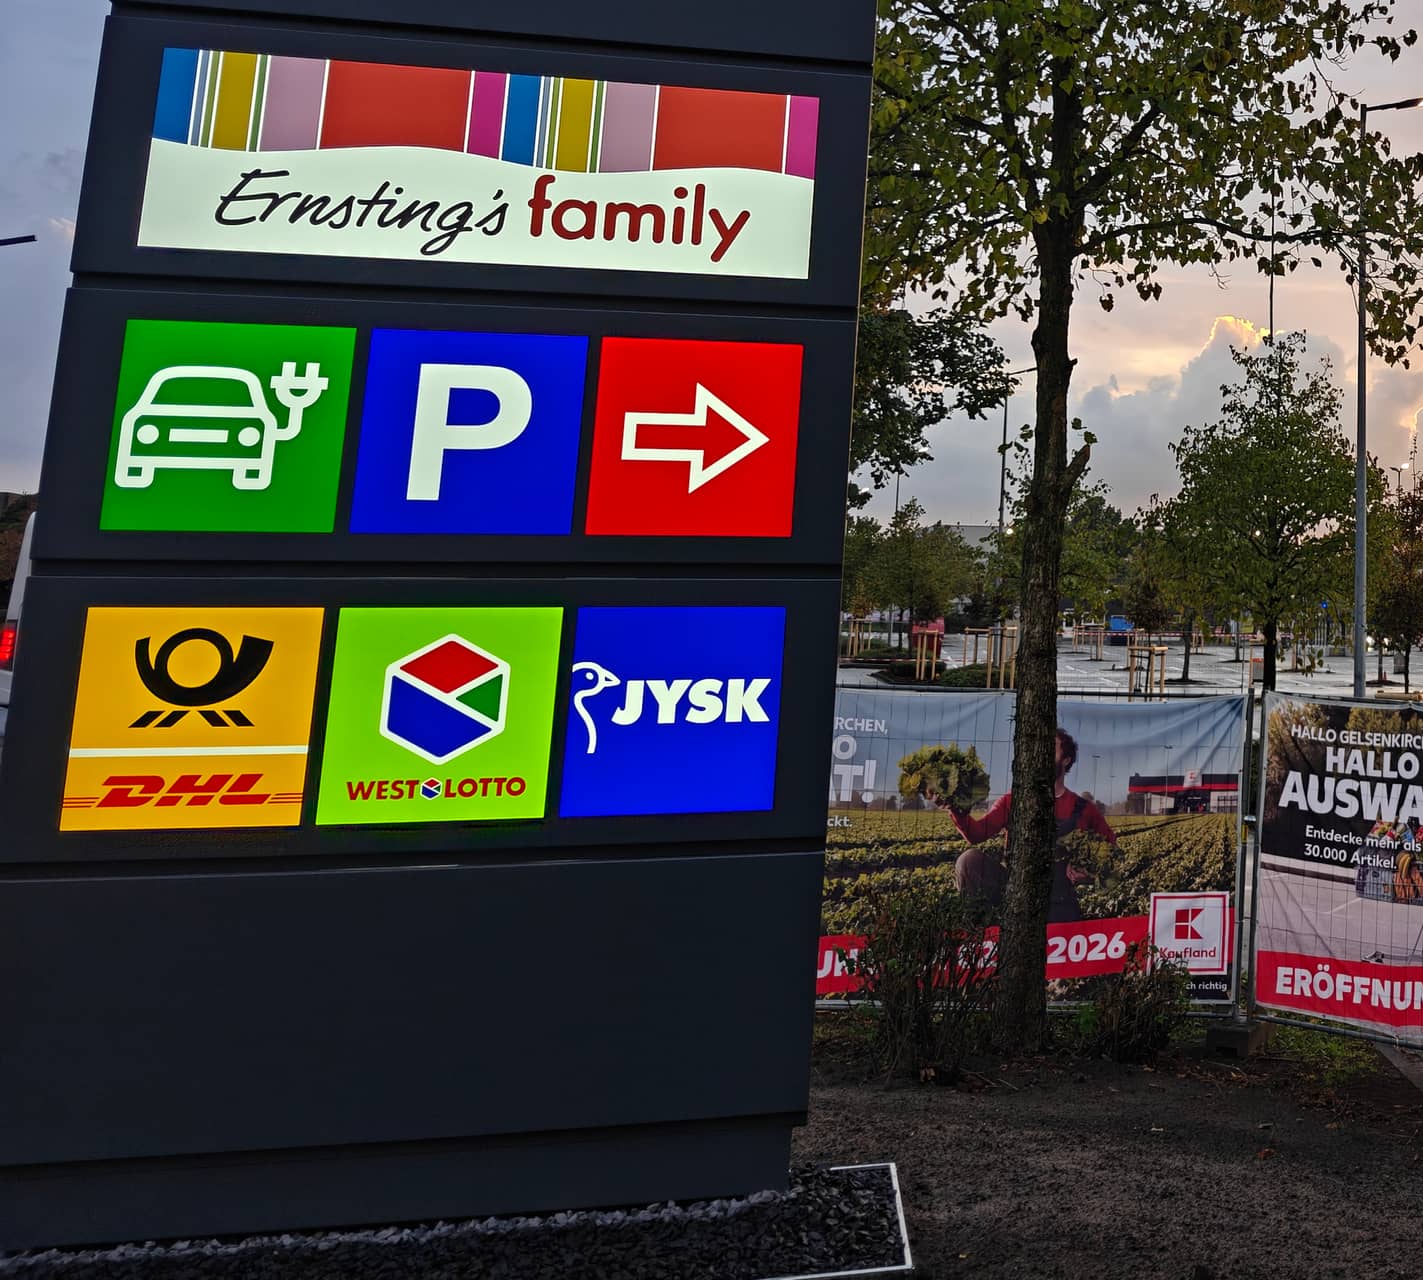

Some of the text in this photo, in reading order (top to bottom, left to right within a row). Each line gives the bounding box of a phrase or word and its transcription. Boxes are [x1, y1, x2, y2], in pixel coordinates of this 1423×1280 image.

[215, 168, 751, 263] Ernsting's family
[406, 363, 533, 501] P
[611, 678, 772, 726] JYSK
[834, 716, 889, 735] RCHEN,
[1291, 724, 1338, 743] HALLO
[1326, 746, 1421, 780] HALLO
[96, 773, 272, 808] DHL
[346, 776, 527, 801] WEST LOTTO
[1305, 825, 1422, 852] Entdecke mehr als
[1303, 843, 1398, 870] 30.000 Artikel.
[1159, 946, 1217, 960] Kaufland
[1198, 981, 1228, 992] richtig
